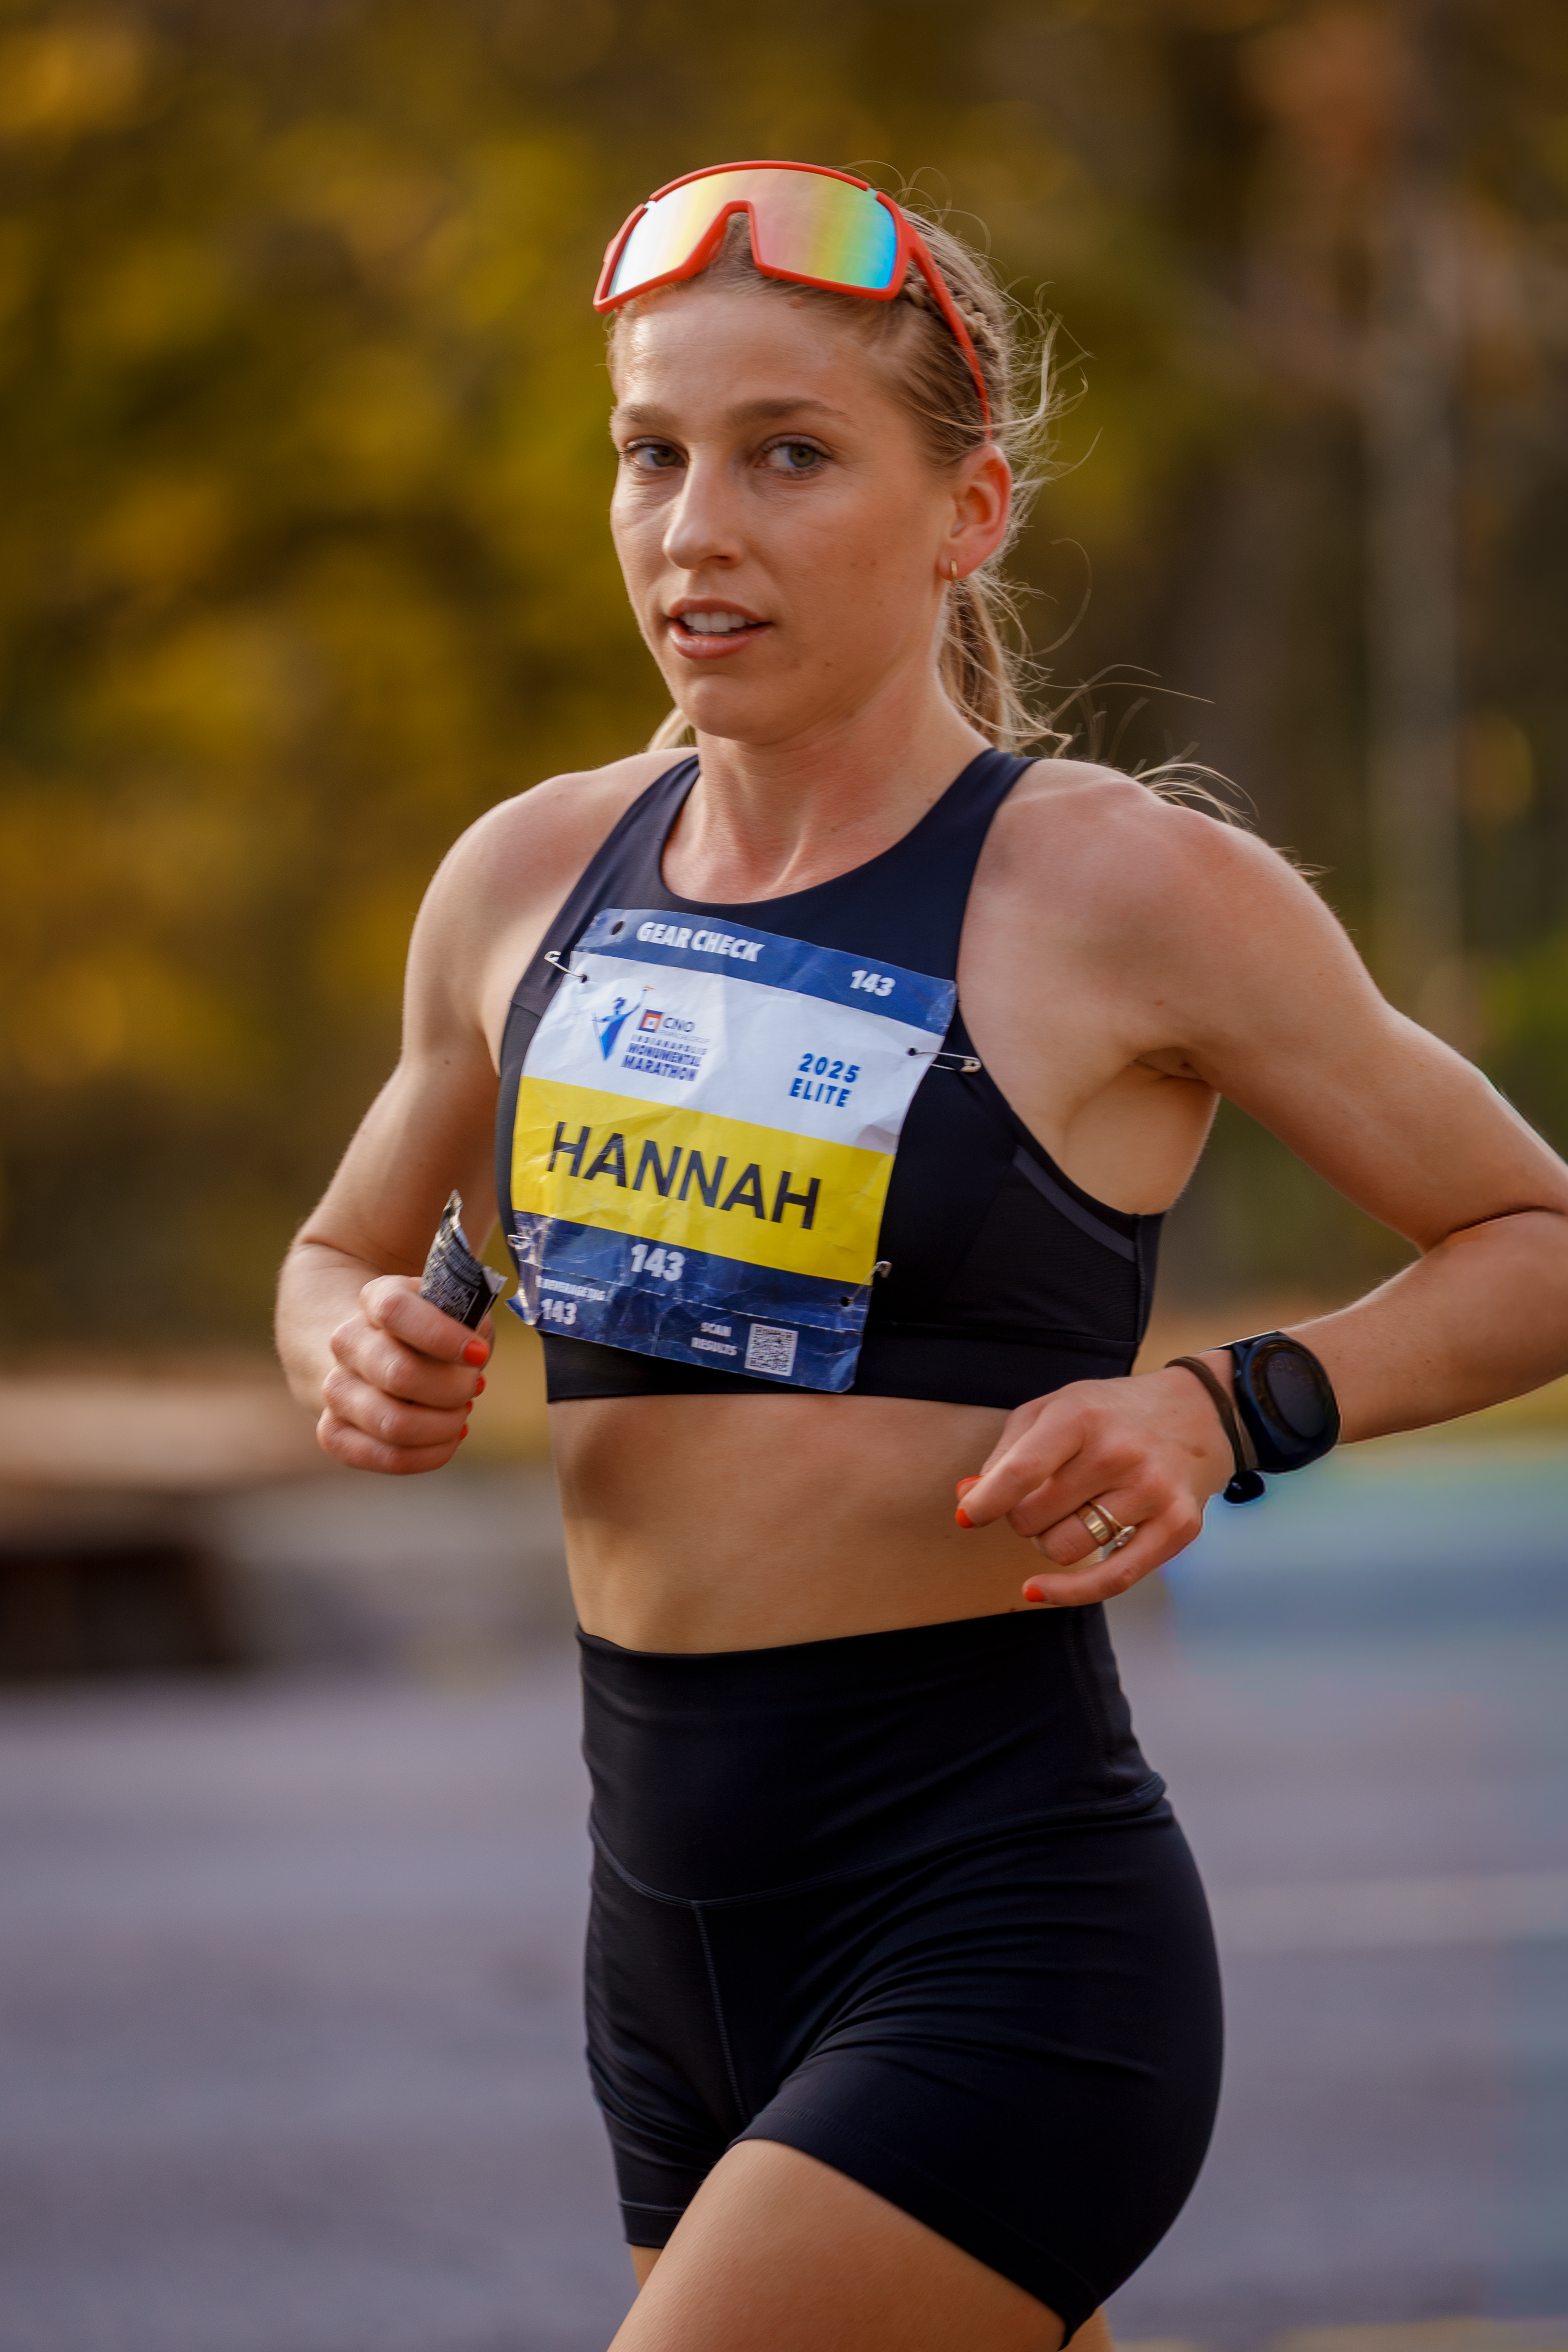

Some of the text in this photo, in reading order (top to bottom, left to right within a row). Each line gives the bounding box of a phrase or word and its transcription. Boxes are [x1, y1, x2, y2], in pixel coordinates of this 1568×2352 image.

[636, 922, 765, 962] GEAR CHECK
[849, 970, 896, 997] 143
[663, 1017, 696, 1033] CNO
[625, 1042, 702, 1067] MONUMENTAL
[631, 1034, 708, 1055] INDIANAPOLIS
[621, 1055, 699, 1082] MARATHON
[797, 1053, 861, 1083] 2025
[789, 1078, 852, 1108] ELITE
[547, 1121, 822, 1230] HANNAH
[631, 1243, 685, 1281] 143
[541, 1298, 578, 1325] 143
[700, 1322, 732, 1337] SCAN
[691, 1337, 737, 1355] RESULTS
